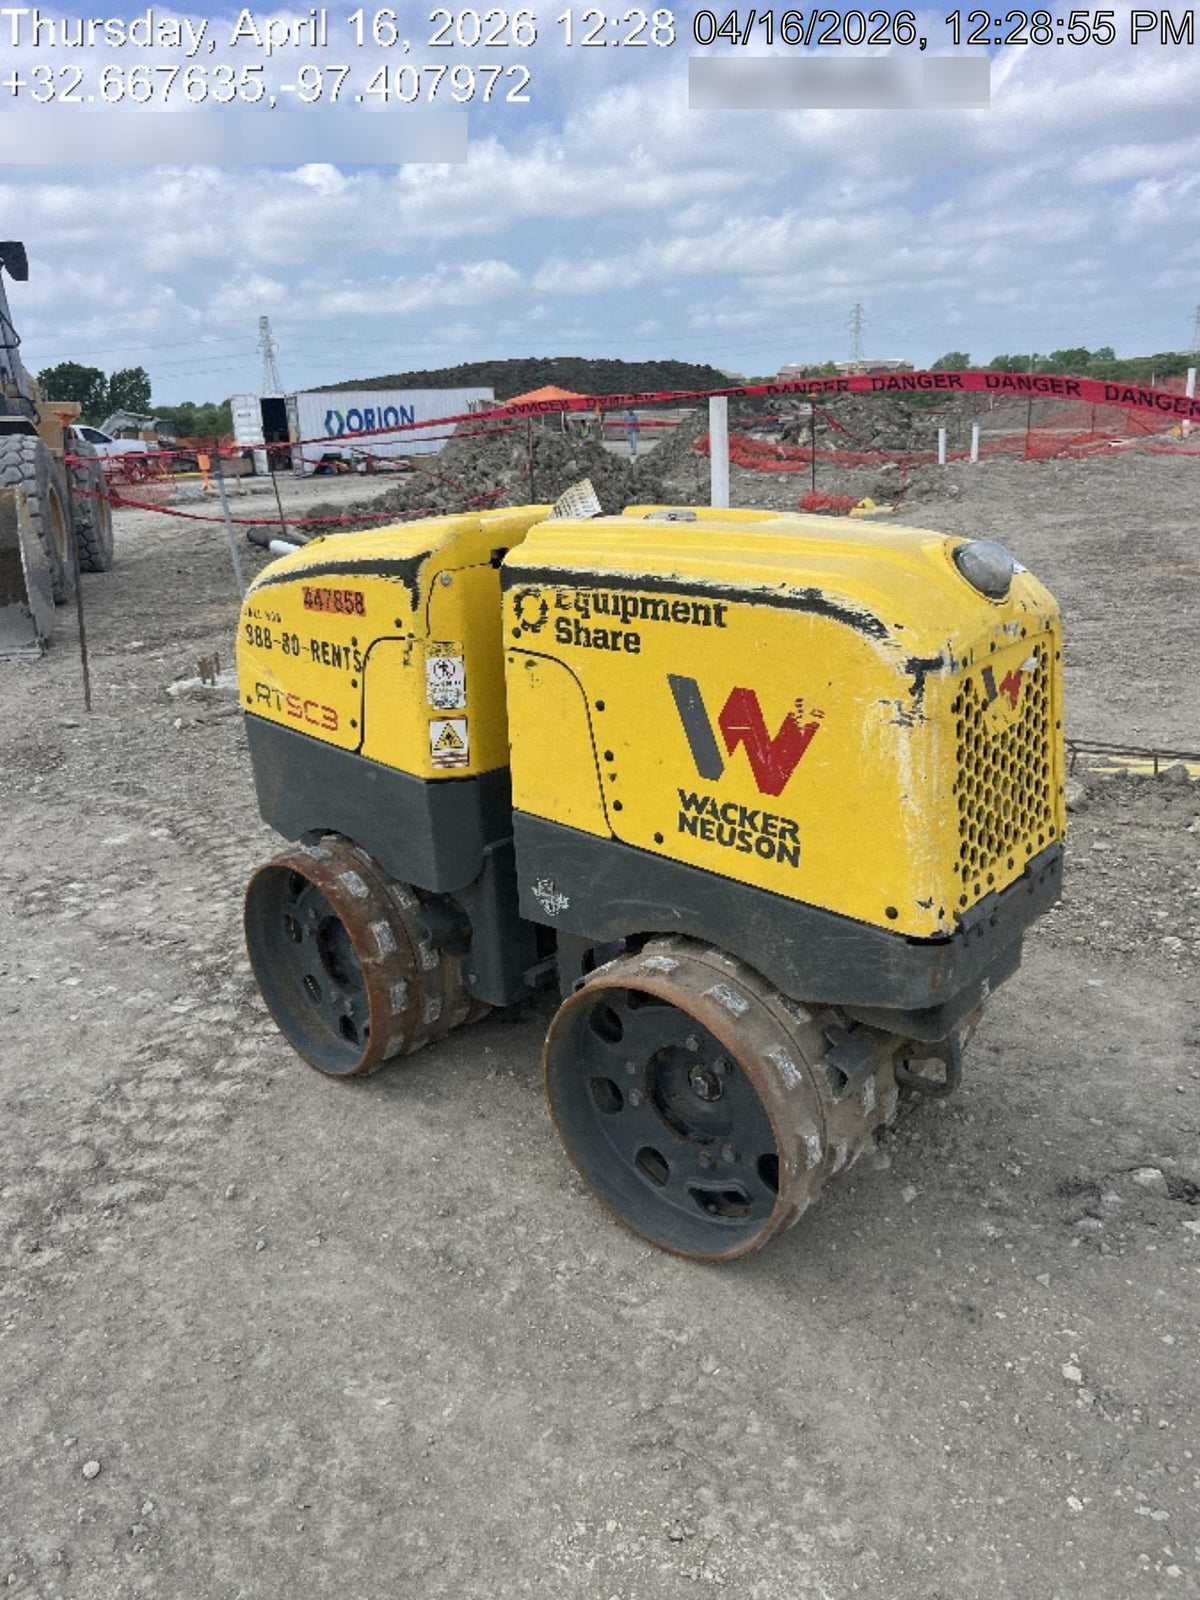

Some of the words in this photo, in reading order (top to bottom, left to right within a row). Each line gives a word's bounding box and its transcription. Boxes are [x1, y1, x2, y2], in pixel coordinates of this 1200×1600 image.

[767, 379, 849, 395] DANGER
[871, 374, 964, 392] DANGER
[984, 374, 1082, 397] DANGER
[346, 405, 414, 432] ORION
[303, 587, 365, 616] 447858
[555, 589, 728, 628] Equipment
[554, 616, 641, 654] Share
[677, 788, 802, 844] WACKER
[677, 811, 802, 868] NEUSON
